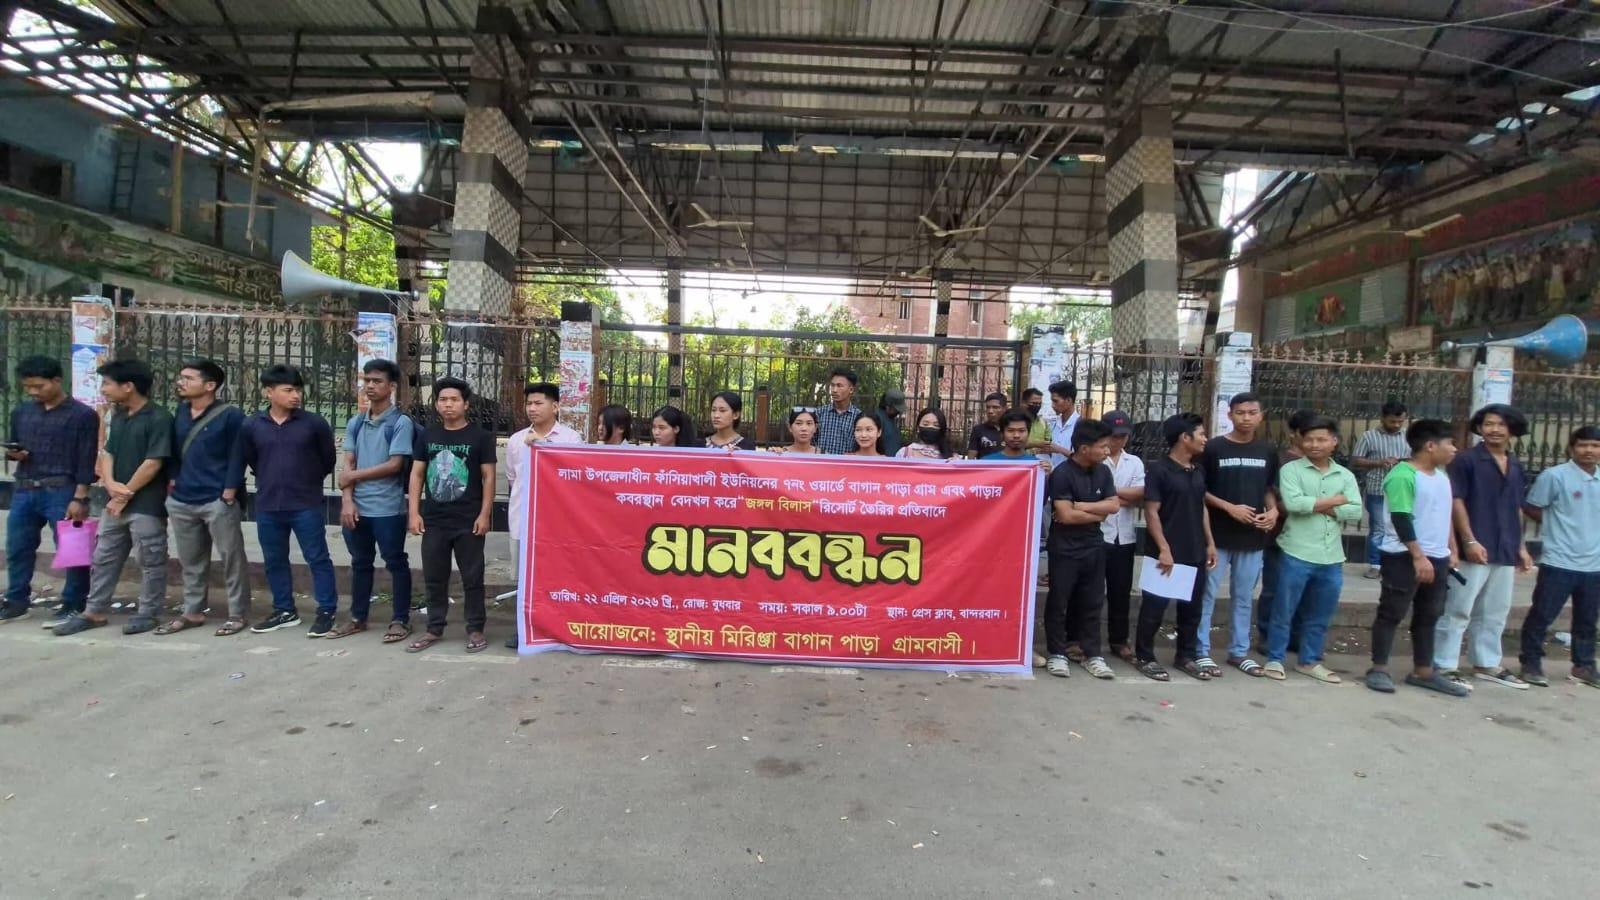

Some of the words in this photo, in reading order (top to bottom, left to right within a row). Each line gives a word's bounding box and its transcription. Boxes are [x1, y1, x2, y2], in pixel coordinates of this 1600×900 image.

[214, 274, 283, 302] বাংলাদে
[558, 467, 582, 481] লামা
[585, 467, 650, 484] উপজেলাধীন
[655, 469, 717, 487] ফাঁসিয়াখালী
[720, 472, 778, 490] ইউনিয়নের
[783, 479, 806, 491] ৭নং
[809, 477, 846, 494] ওয়ার্ডে
[849, 478, 881, 495] বাগান
[885, 482, 911, 497] পাড়া
[914, 483, 936, 497] গ্রাম
[941, 483, 966, 498] এবং
[970, 484, 1002, 499] পাড়ার
[616, 491, 663, 509] কবরস্থান
[671, 492, 709, 508] বেদখল
[860, 501, 894, 516] তৈরির
[898, 504, 947, 518] প্রতিবাদে
[644, 523, 923, 586] মানববন্ধন
[549, 591, 581, 603] তারিখ:
[584, 592, 598, 605] ২২
[601, 592, 628, 607] এপ্রিল
[630, 593, 660, 607] ২০২৬
[682, 598, 709, 610] রোজ:
[711, 598, 742, 612] বুধবার
[759, 600, 788, 614] সময়:
[792, 602, 824, 618] সকাল
[826, 602, 867, 618] ৯.০০টা
[886, 606, 908, 620] স্থান:
[911, 606, 932, 619] প্রেস
[934, 608, 956, 622] ক্লাব,
[959, 608, 1000, 621] বান্দরবান
[567, 620, 656, 644] আয়োজনে:
[664, 622, 715, 648] স্থানীয়
[720, 624, 776, 650] মিরিঞ্জা
[783, 630, 833, 652] বাগান
[840, 634, 880, 656] পাড়া
[892, 631, 963, 656] গ্রামবাসী
